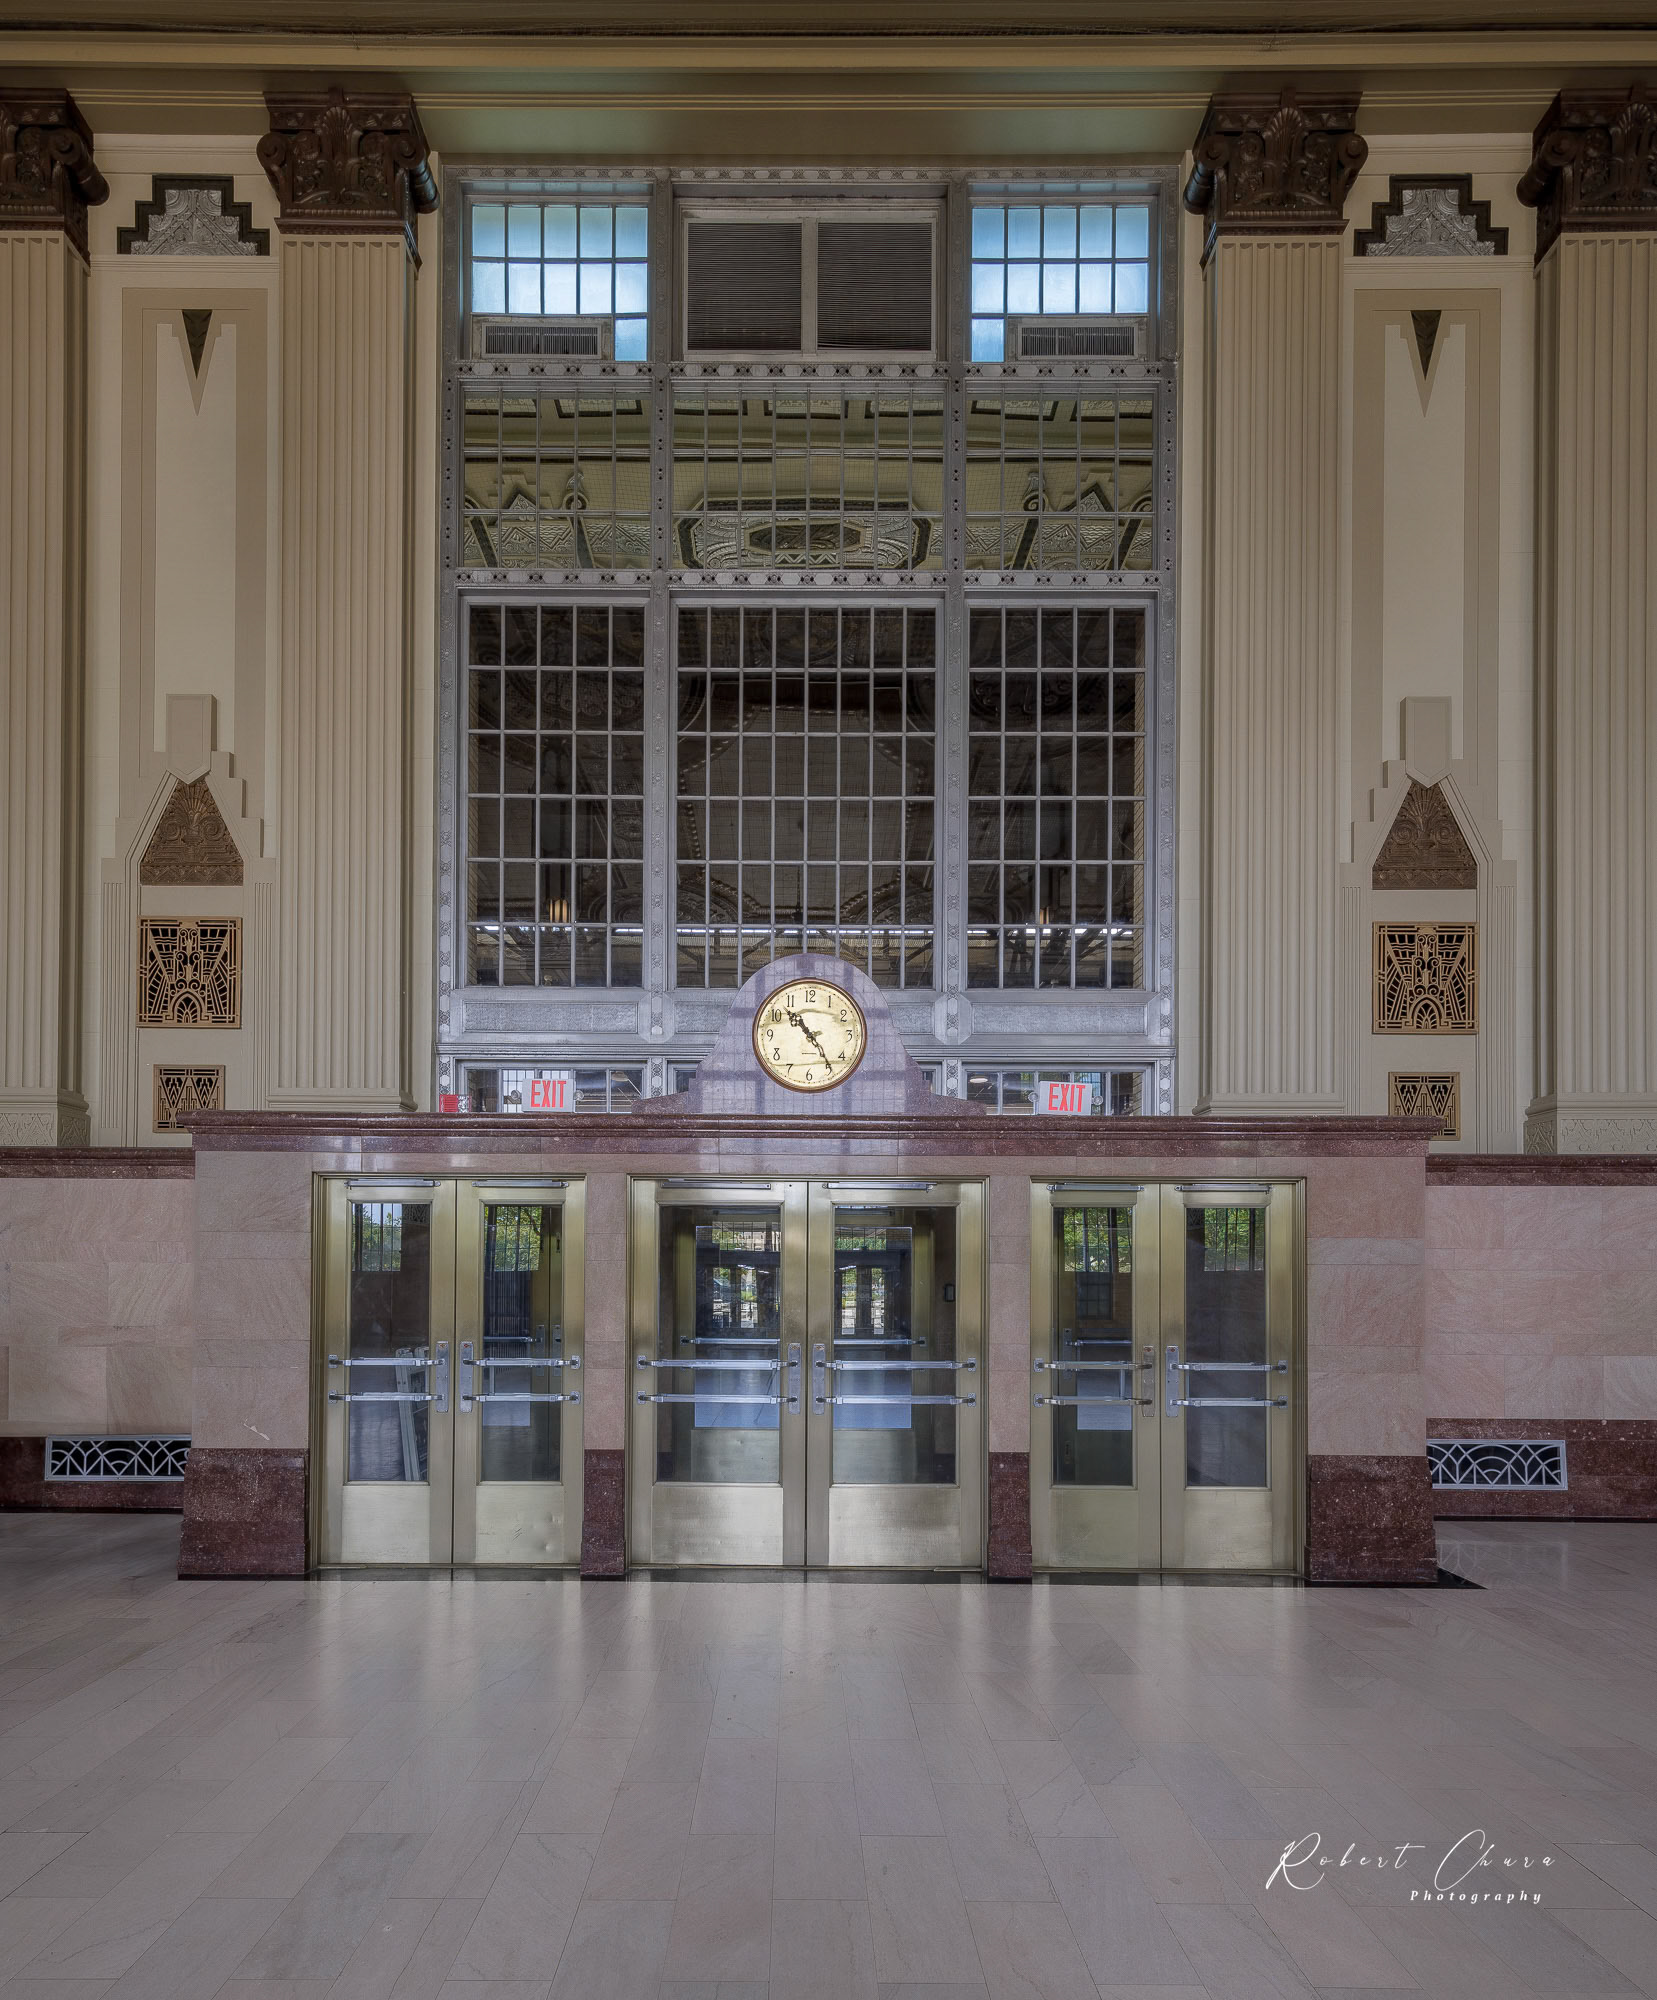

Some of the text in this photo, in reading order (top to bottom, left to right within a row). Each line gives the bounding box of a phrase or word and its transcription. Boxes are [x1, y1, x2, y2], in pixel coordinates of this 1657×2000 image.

[787, 995, 795, 1008] 11
[805, 990, 816, 1003] 12
[771, 1009, 782, 1022] 10
[840, 1009, 847, 1022] 2
[766, 1029, 773, 1041] 9
[846, 1030, 853, 1043] 3
[773, 1048, 780, 1061] 8
[838, 1049, 846, 1061] 4
[786, 1064, 794, 1075] 7
[806, 1068, 813, 1081] 6
[825, 1064, 832, 1076] 5
[531, 1080, 567, 1108] EXIT
[1048, 1083, 1086, 1112] EXIT
